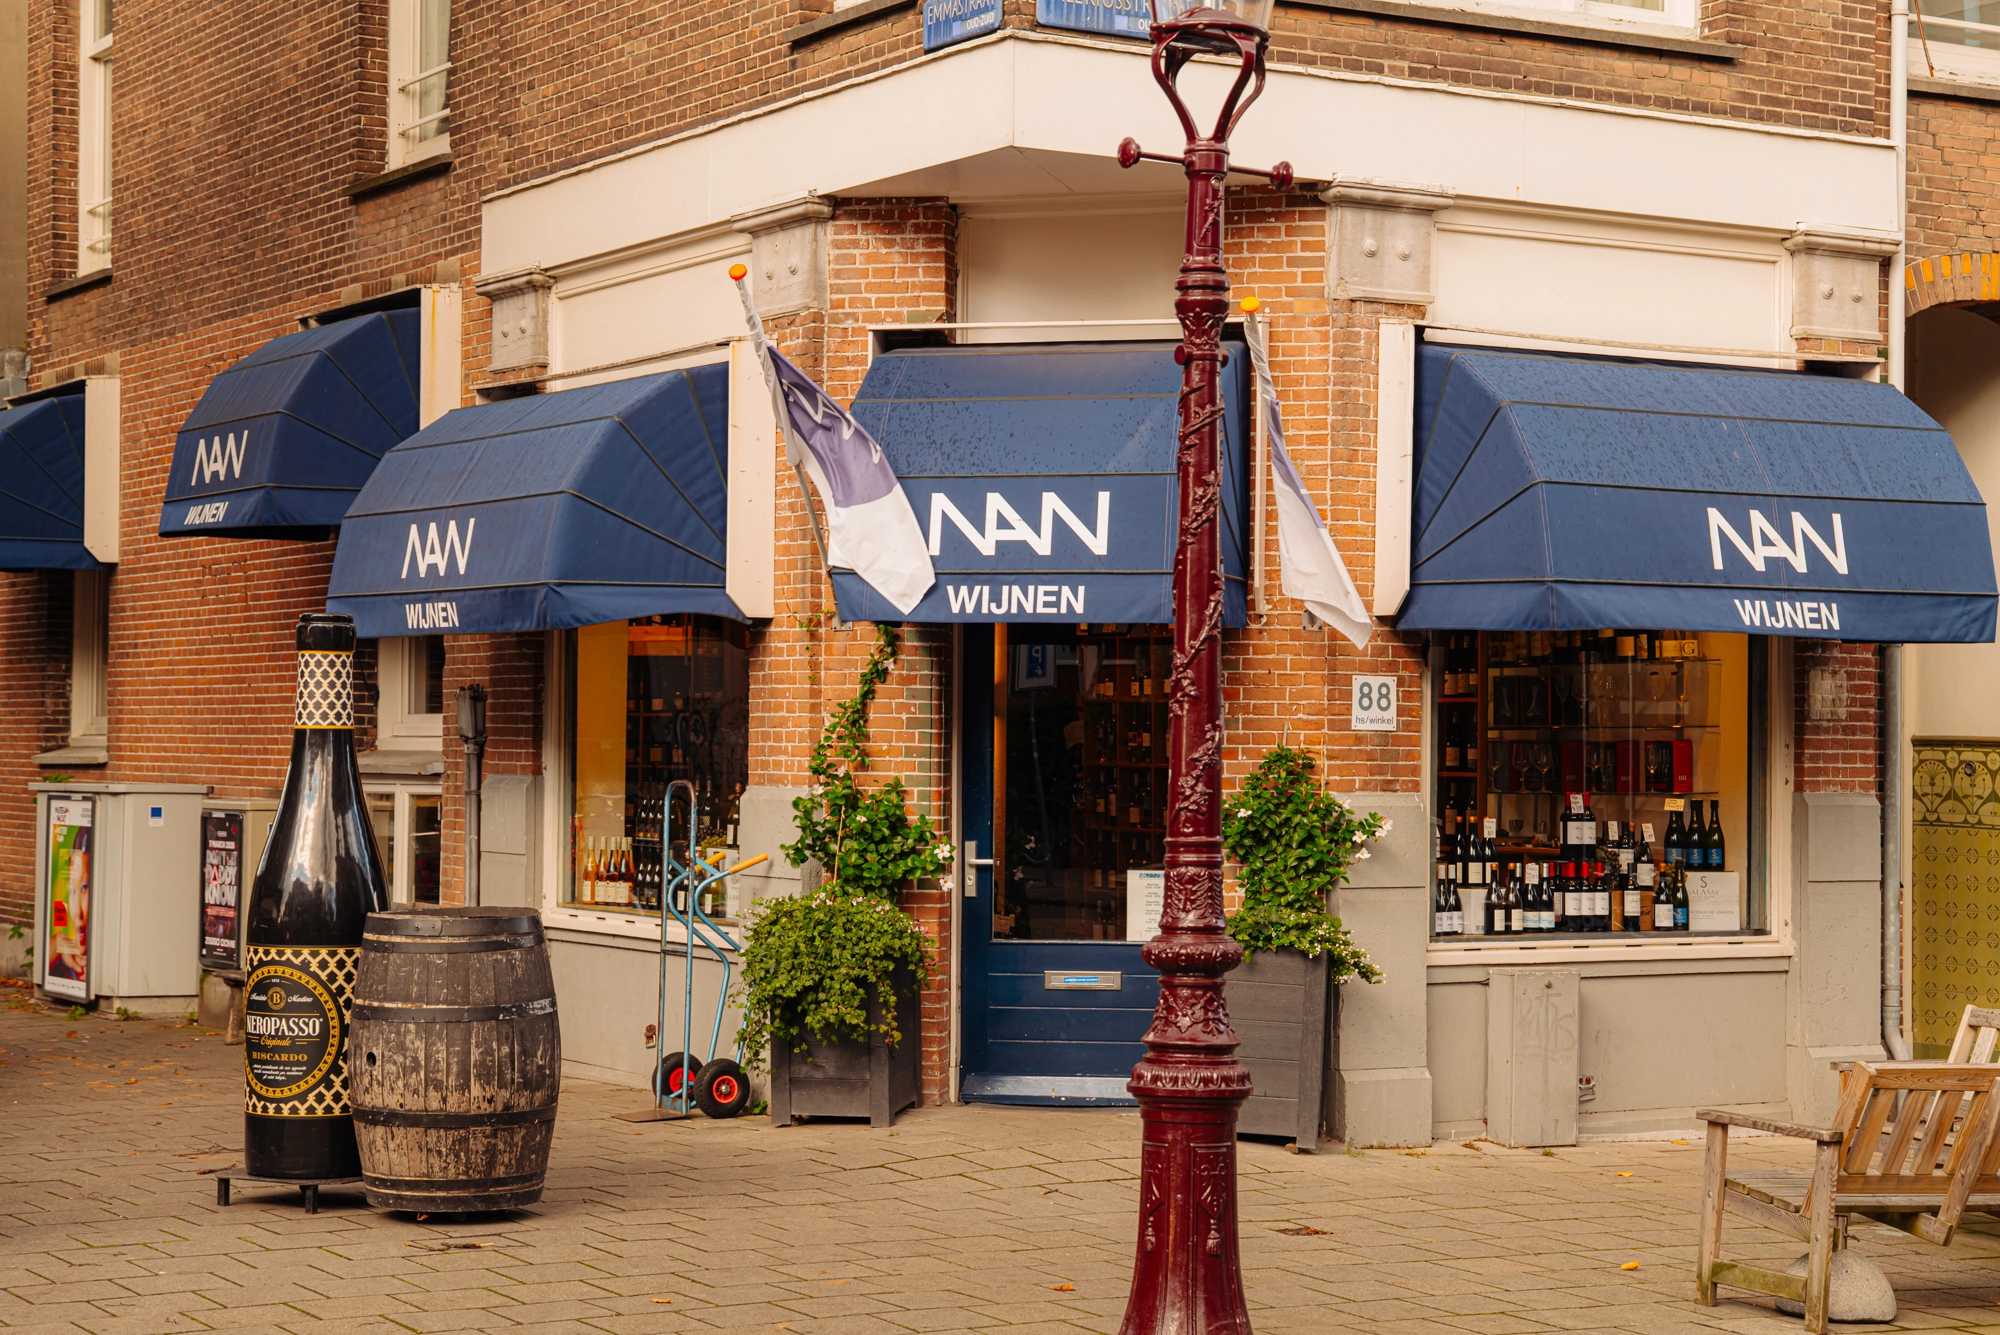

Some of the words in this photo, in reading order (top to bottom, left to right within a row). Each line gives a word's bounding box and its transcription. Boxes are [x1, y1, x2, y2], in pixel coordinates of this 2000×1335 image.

[966, 12, 995, 30] OUD-ZUID
[191, 430, 249, 486] NAN
[183, 501, 229, 526] WIJNEN
[929, 491, 1110, 556] NAN
[401, 517, 476, 579] NAN
[1706, 507, 1849, 575] NAN
[946, 585, 1085, 614] WIJNEN
[405, 601, 459, 629] WIJNEN
[1733, 598, 1840, 631] WIJNEN
[1682, 641, 1695, 655] G
[1358, 681, 1392, 712] 88
[1355, 715, 1394, 725] hs/winkel
[205, 864, 238, 885] DADDY
[1700, 875, 1708, 888] S
[205, 882, 238, 906] KNOW
[204, 936, 220, 947] ZIGGO
[220, 939, 236, 949] DOME
[272, 992, 281, 1004] B
[246, 1014, 320, 1037] NEROPASSO
[260, 1034, 292, 1048] Originale
[251, 1051, 308, 1062] BISCARDO
